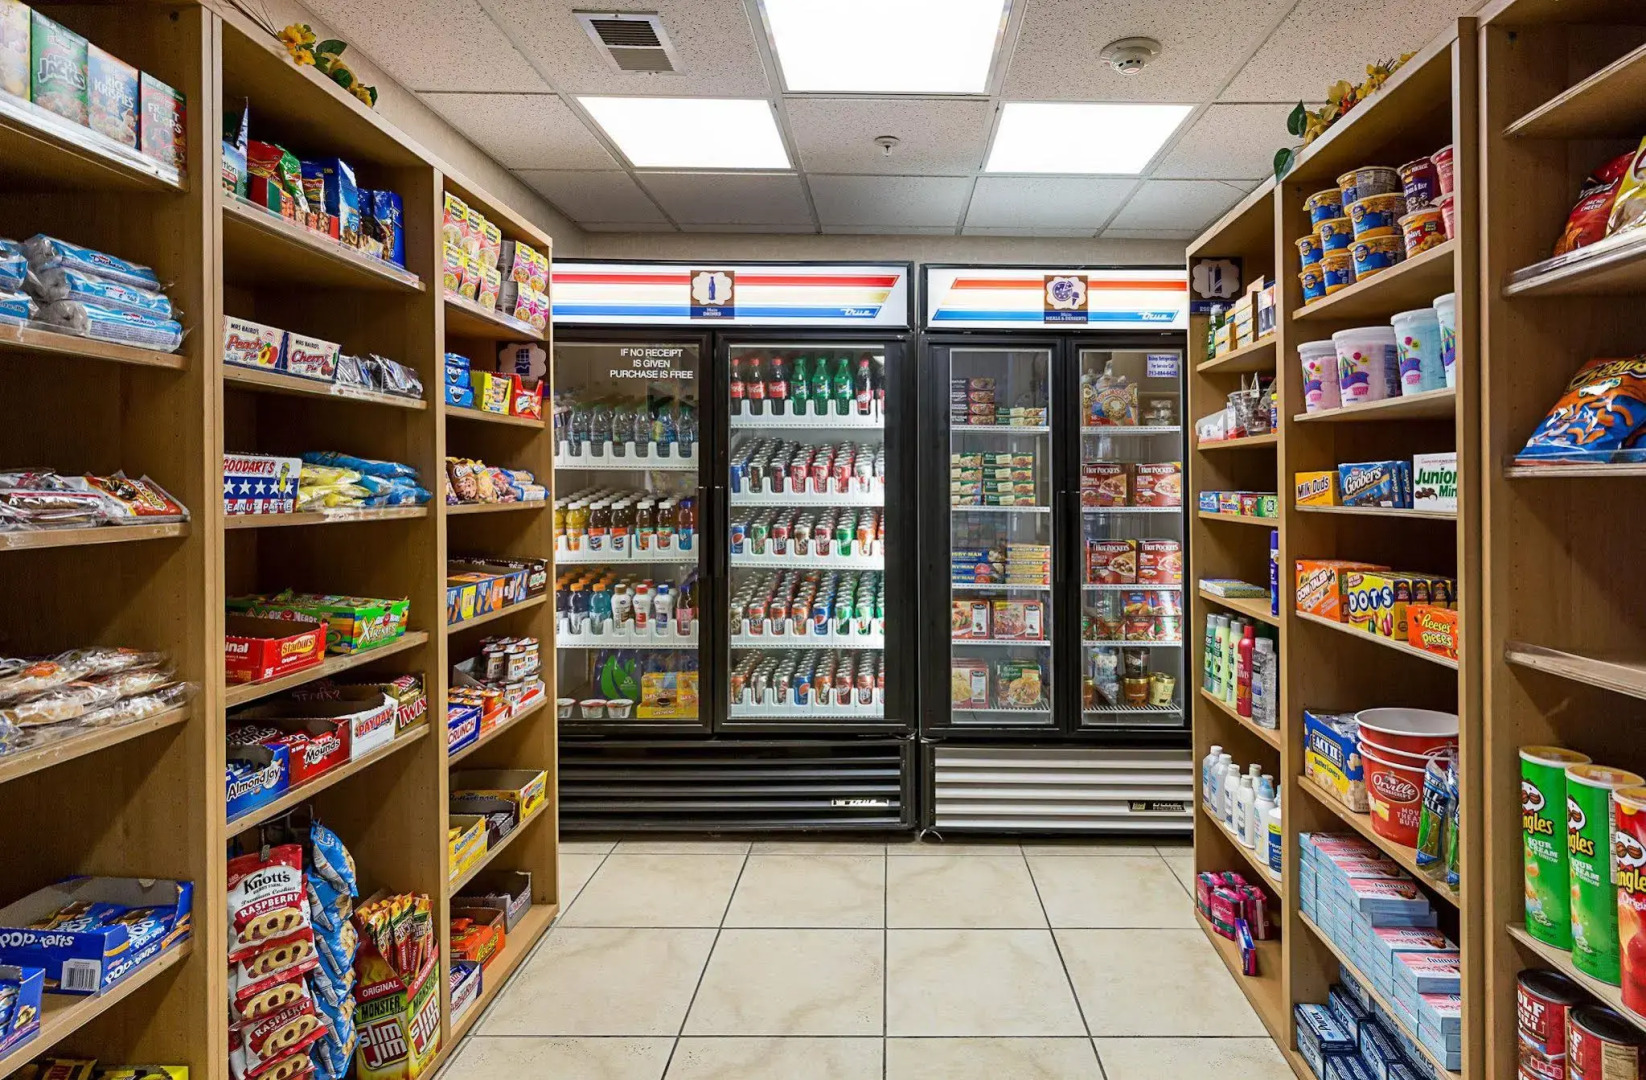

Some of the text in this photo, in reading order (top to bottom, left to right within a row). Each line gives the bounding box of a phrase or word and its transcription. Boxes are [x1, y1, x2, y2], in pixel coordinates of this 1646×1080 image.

[226, 333, 263, 351] Peach
[243, 351, 257, 361] Pie
[291, 349, 330, 366] Cherry
[621, 349, 683, 357] IF NO RECEIPT
[306, 364, 317, 372] Pie
[633, 360, 670, 368] IS GIVEN
[610, 370, 693, 379] PURCHASE IS FREE
[224, 458, 275, 475] GOODART'S
[1152, 466, 1175, 474] POCKETS
[1297, 476, 1329, 498] Milk Duds
[1345, 466, 1382, 495] Goobers
[263, 502, 293, 513] PATTIE
[1348, 586, 1394, 612] DOTS
[1422, 614, 1451, 633] Reese's
[448, 721, 476, 744] CRUNCH
[305, 738, 341, 763] Mounds
[1315, 737, 1329, 753] ACT
[1326, 763, 1341, 781] Lovers
[227, 771, 266, 801] Almond
[1373, 774, 1416, 796] Orville
[243, 871, 291, 895] Knott's
[240, 892, 300, 918] RASPBERRY
[413, 955, 437, 990] ORIGINAL
[361, 981, 399, 997] ORIGINAL
[361, 995, 400, 1020] MONSTER
[410, 998, 438, 1039] slim
[360, 1022, 403, 1048] slim
